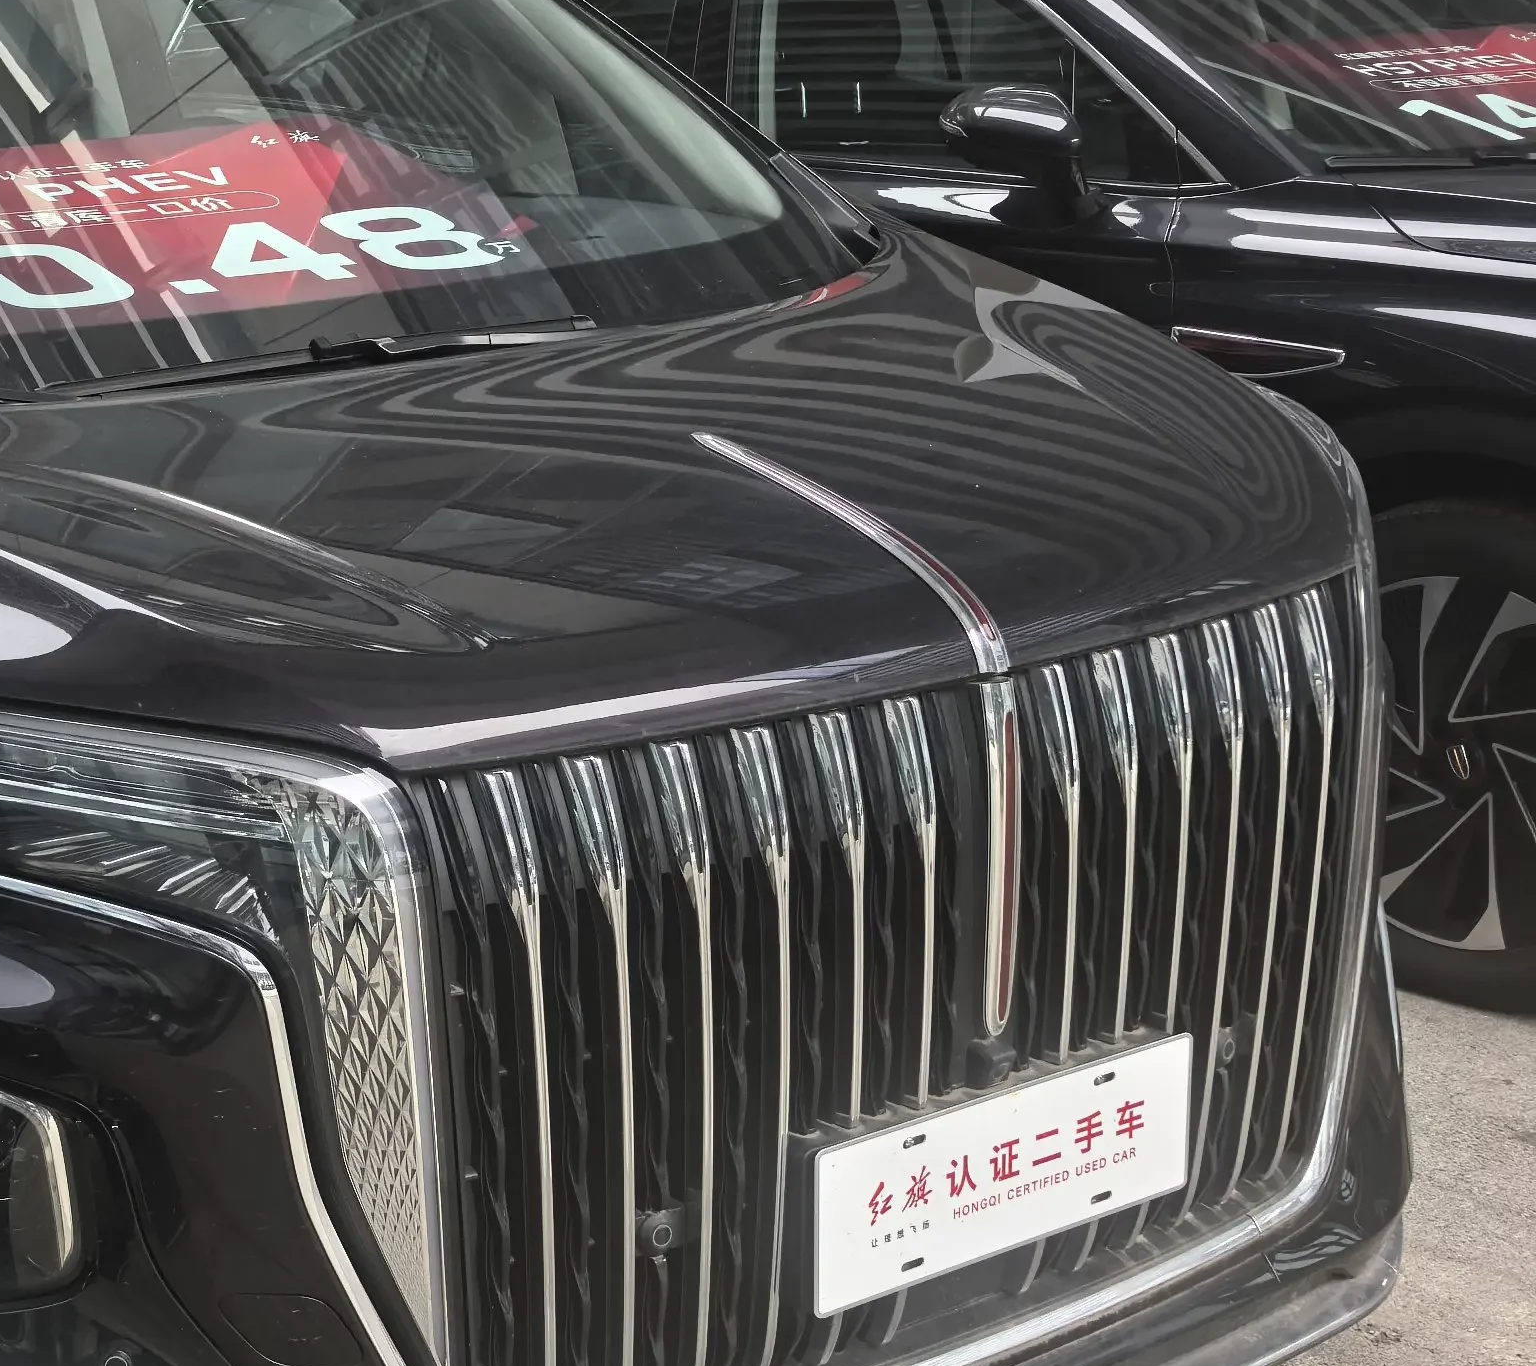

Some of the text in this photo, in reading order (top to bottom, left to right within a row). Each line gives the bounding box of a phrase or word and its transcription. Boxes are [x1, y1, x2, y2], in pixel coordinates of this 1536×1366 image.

[1342, 52, 1536, 77] HS7 PHEV
[29, 165, 230, 203] PHEV
[952, 1147, 1137, 1220] HONGQI CERTIFIED USED CAR
